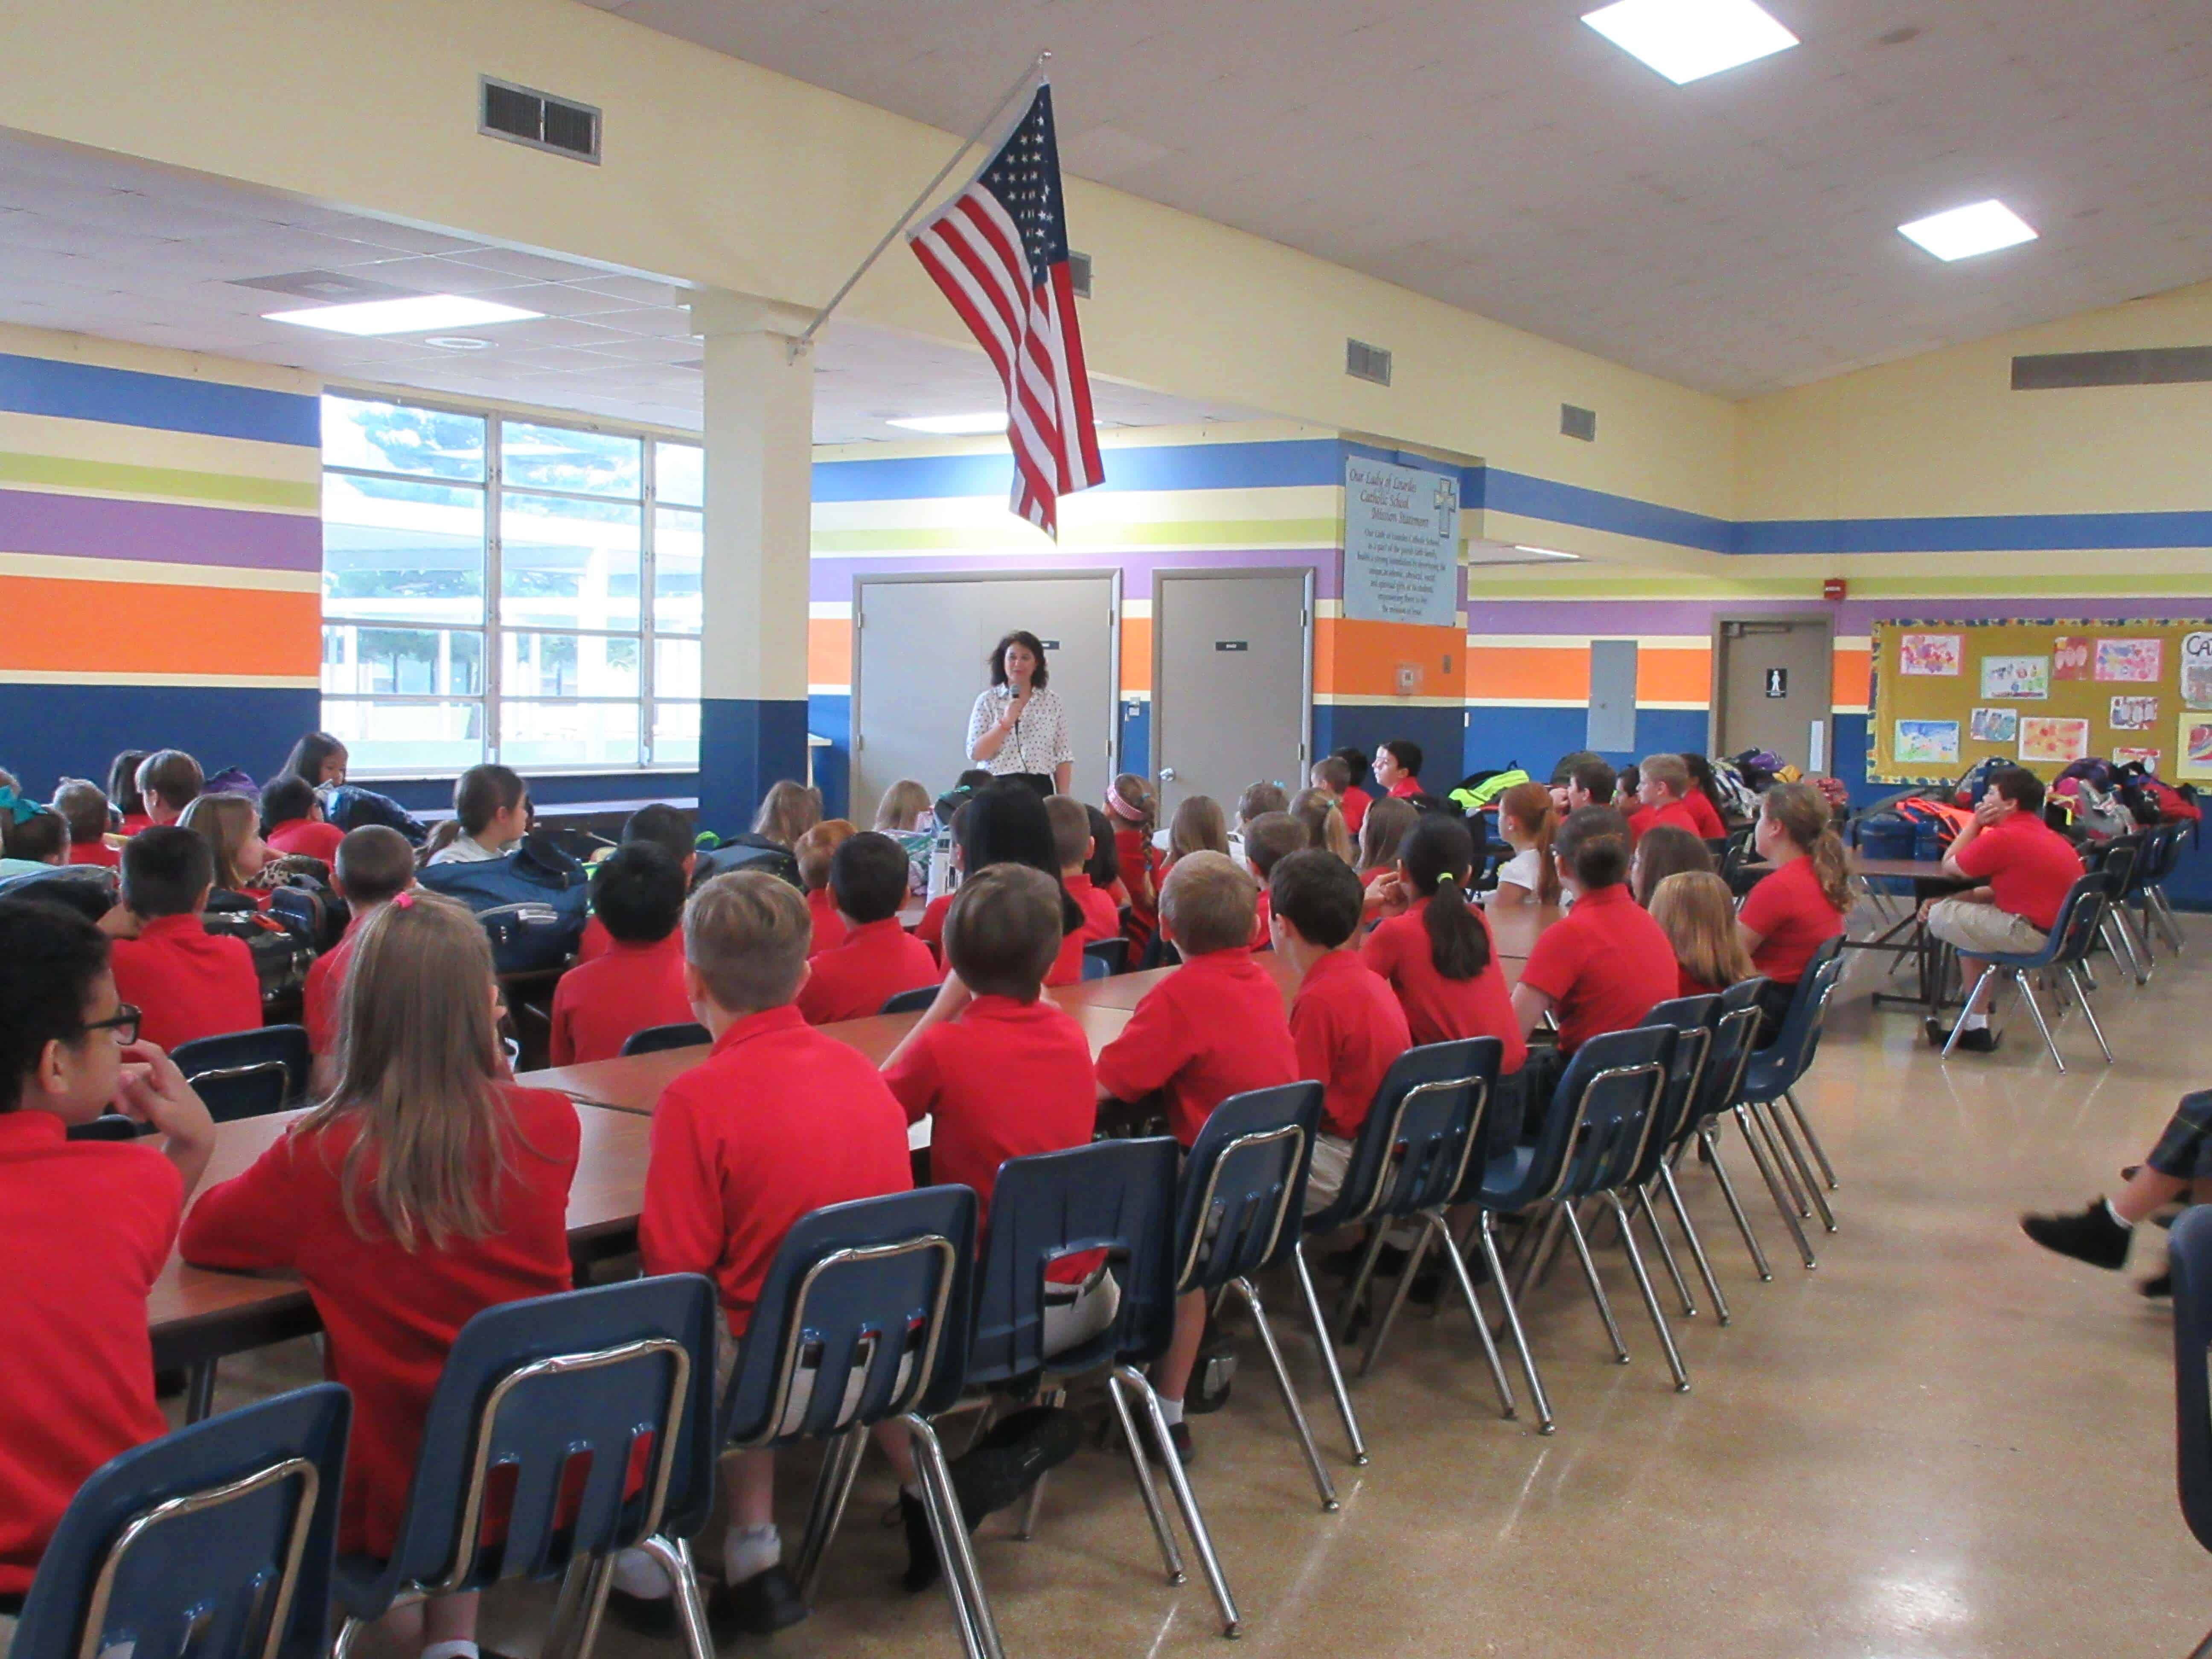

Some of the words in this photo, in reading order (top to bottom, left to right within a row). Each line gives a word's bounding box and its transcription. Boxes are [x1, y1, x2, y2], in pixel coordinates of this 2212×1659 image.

[1350, 469, 1364, 482] Our
[1366, 471, 1383, 490] Lady
[1384, 473, 1392, 491] of
[1389, 492, 1410, 509] School
